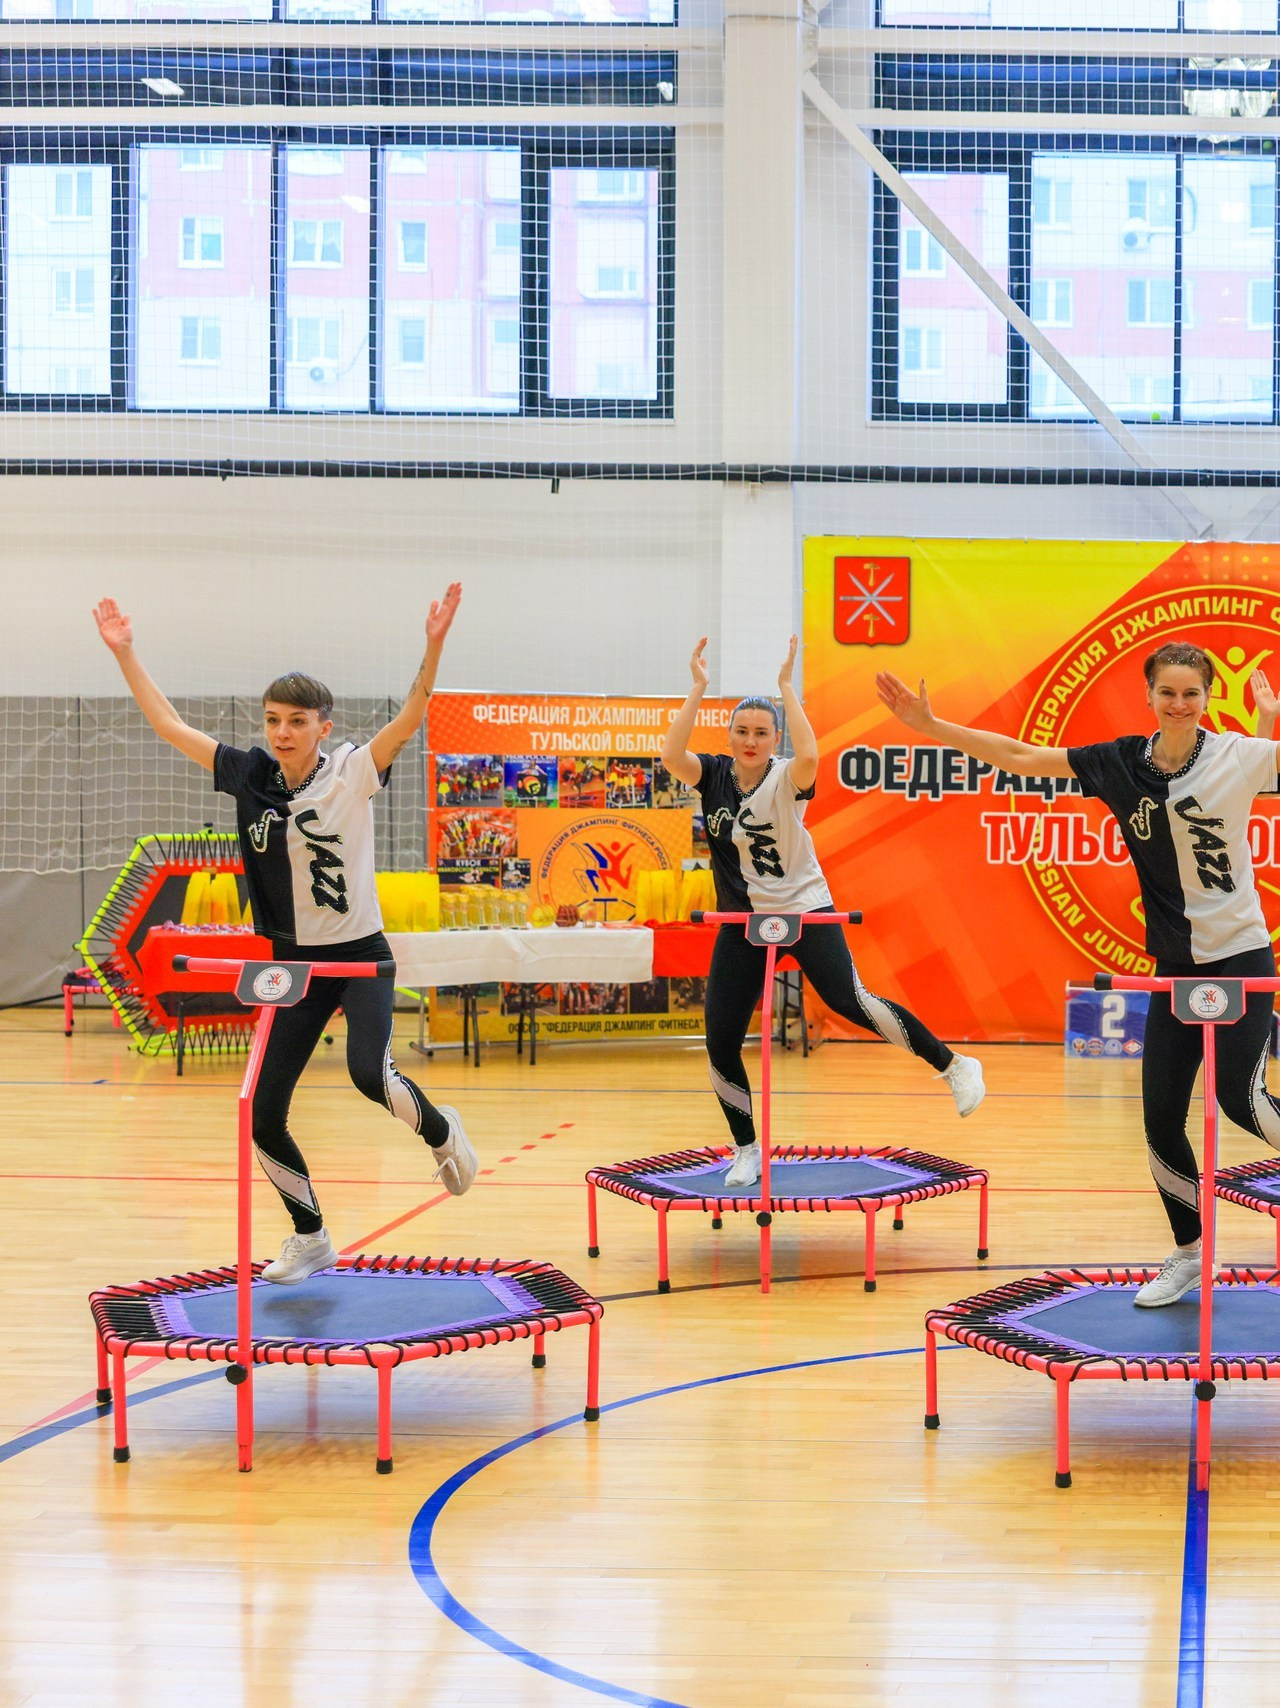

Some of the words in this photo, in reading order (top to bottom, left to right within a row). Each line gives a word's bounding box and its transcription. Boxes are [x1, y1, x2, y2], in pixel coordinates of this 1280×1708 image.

[1030, 640, 1108, 747] ДЕРАЦИЯ
[1110, 596, 1263, 650] ДЖАМПИНГ
[473, 704, 570, 725] ФЕДЕРАЦИЯ
[573, 707, 664, 728] ДЖАМПИНГ
[668, 708, 734, 728] ФТНЕС
[530, 730, 612, 751] ТУЛЬСКОЙ
[616, 732, 666, 752] ОБЛАС
[294, 808, 350, 915] JAZZ
[621, 821, 655, 848] ФИТНЕСА
[653, 847, 668, 870] РОСС
[739, 807, 785, 878] JAZZ
[982, 812, 1134, 865] ТУЛЬС
[1174, 795, 1236, 893] JAZZ
[1083, 929, 1156, 976] JUMP
[542, 1020, 602, 1033] "ФЕДЕРАЦИЯ
[603, 1019, 655, 1033] ДЖАМПИНГ
[658, 1018, 704, 1030] ФИТНЕСА"
[1102, 994, 1125, 1038] 2
